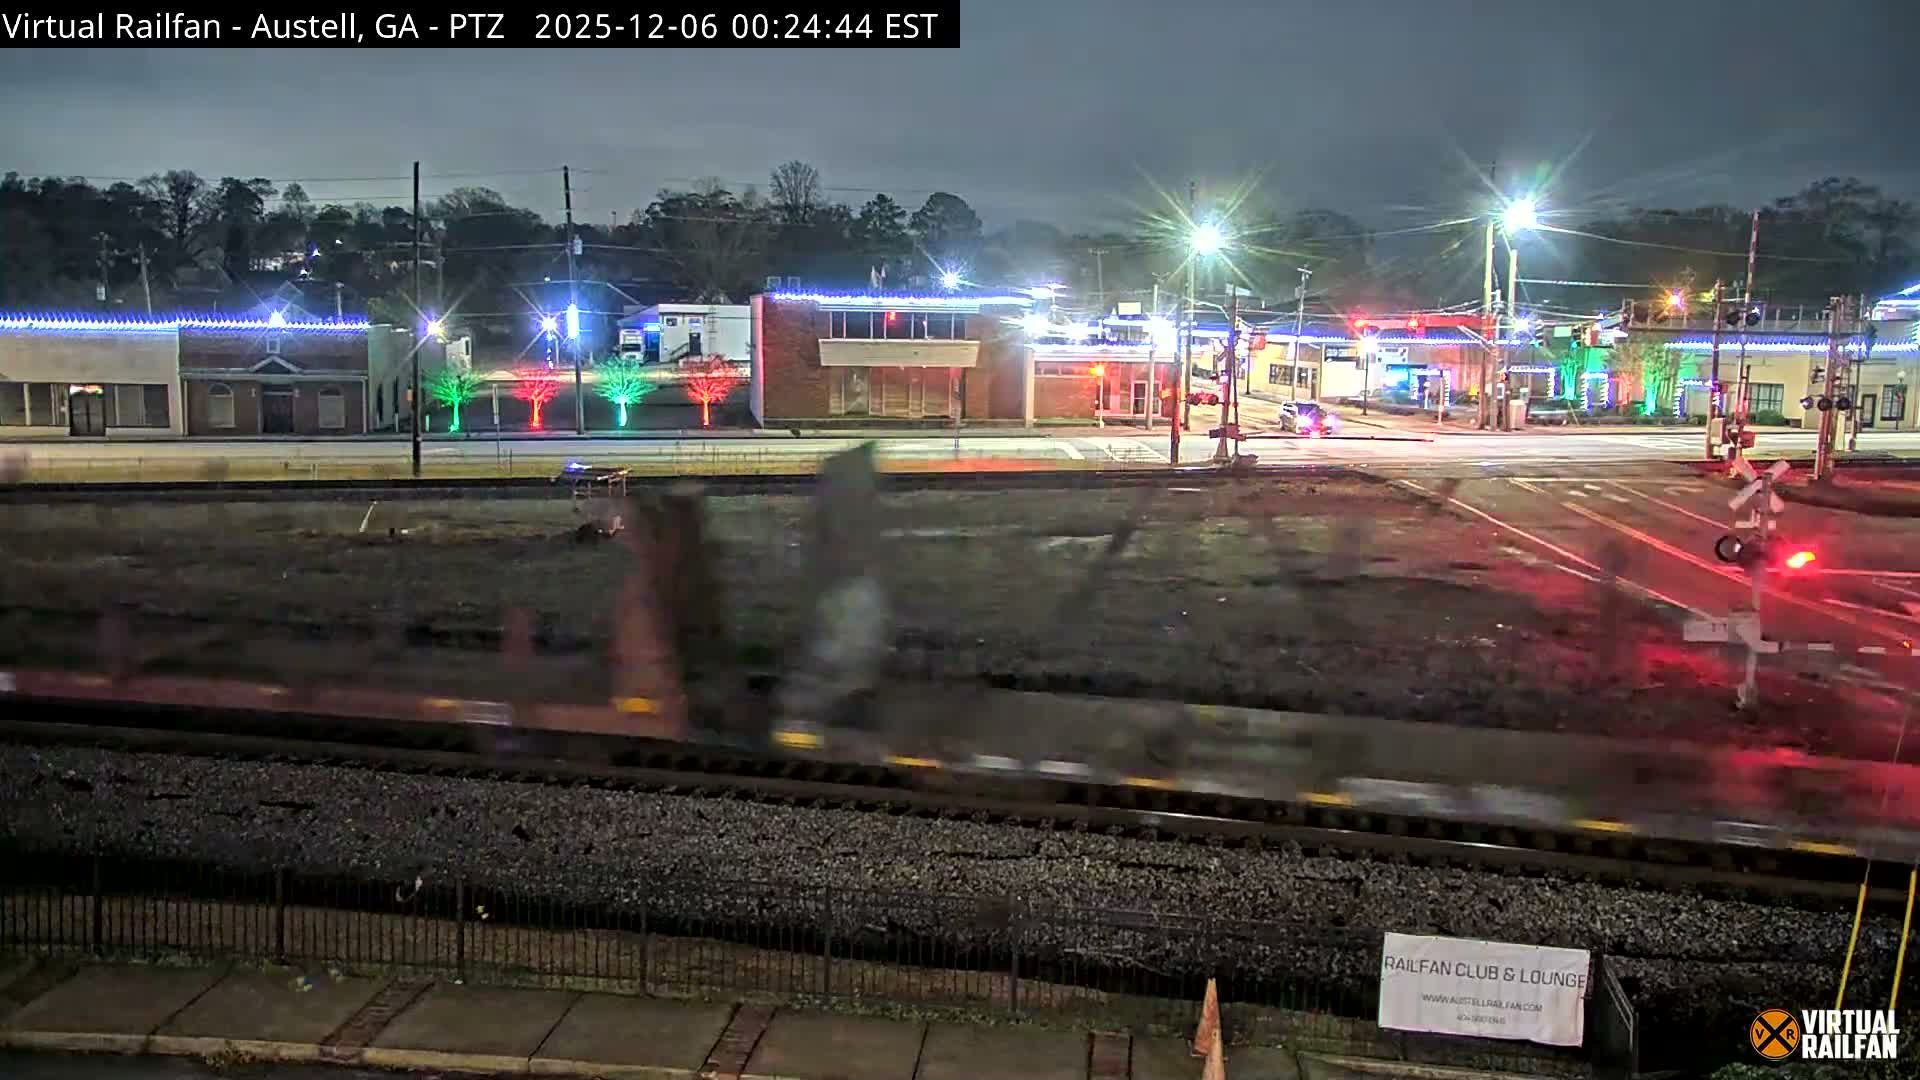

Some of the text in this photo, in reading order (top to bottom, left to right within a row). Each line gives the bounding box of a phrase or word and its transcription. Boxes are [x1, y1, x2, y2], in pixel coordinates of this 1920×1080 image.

[1384, 955, 1587, 989] RAILFAN CLUB & LOUNGE
